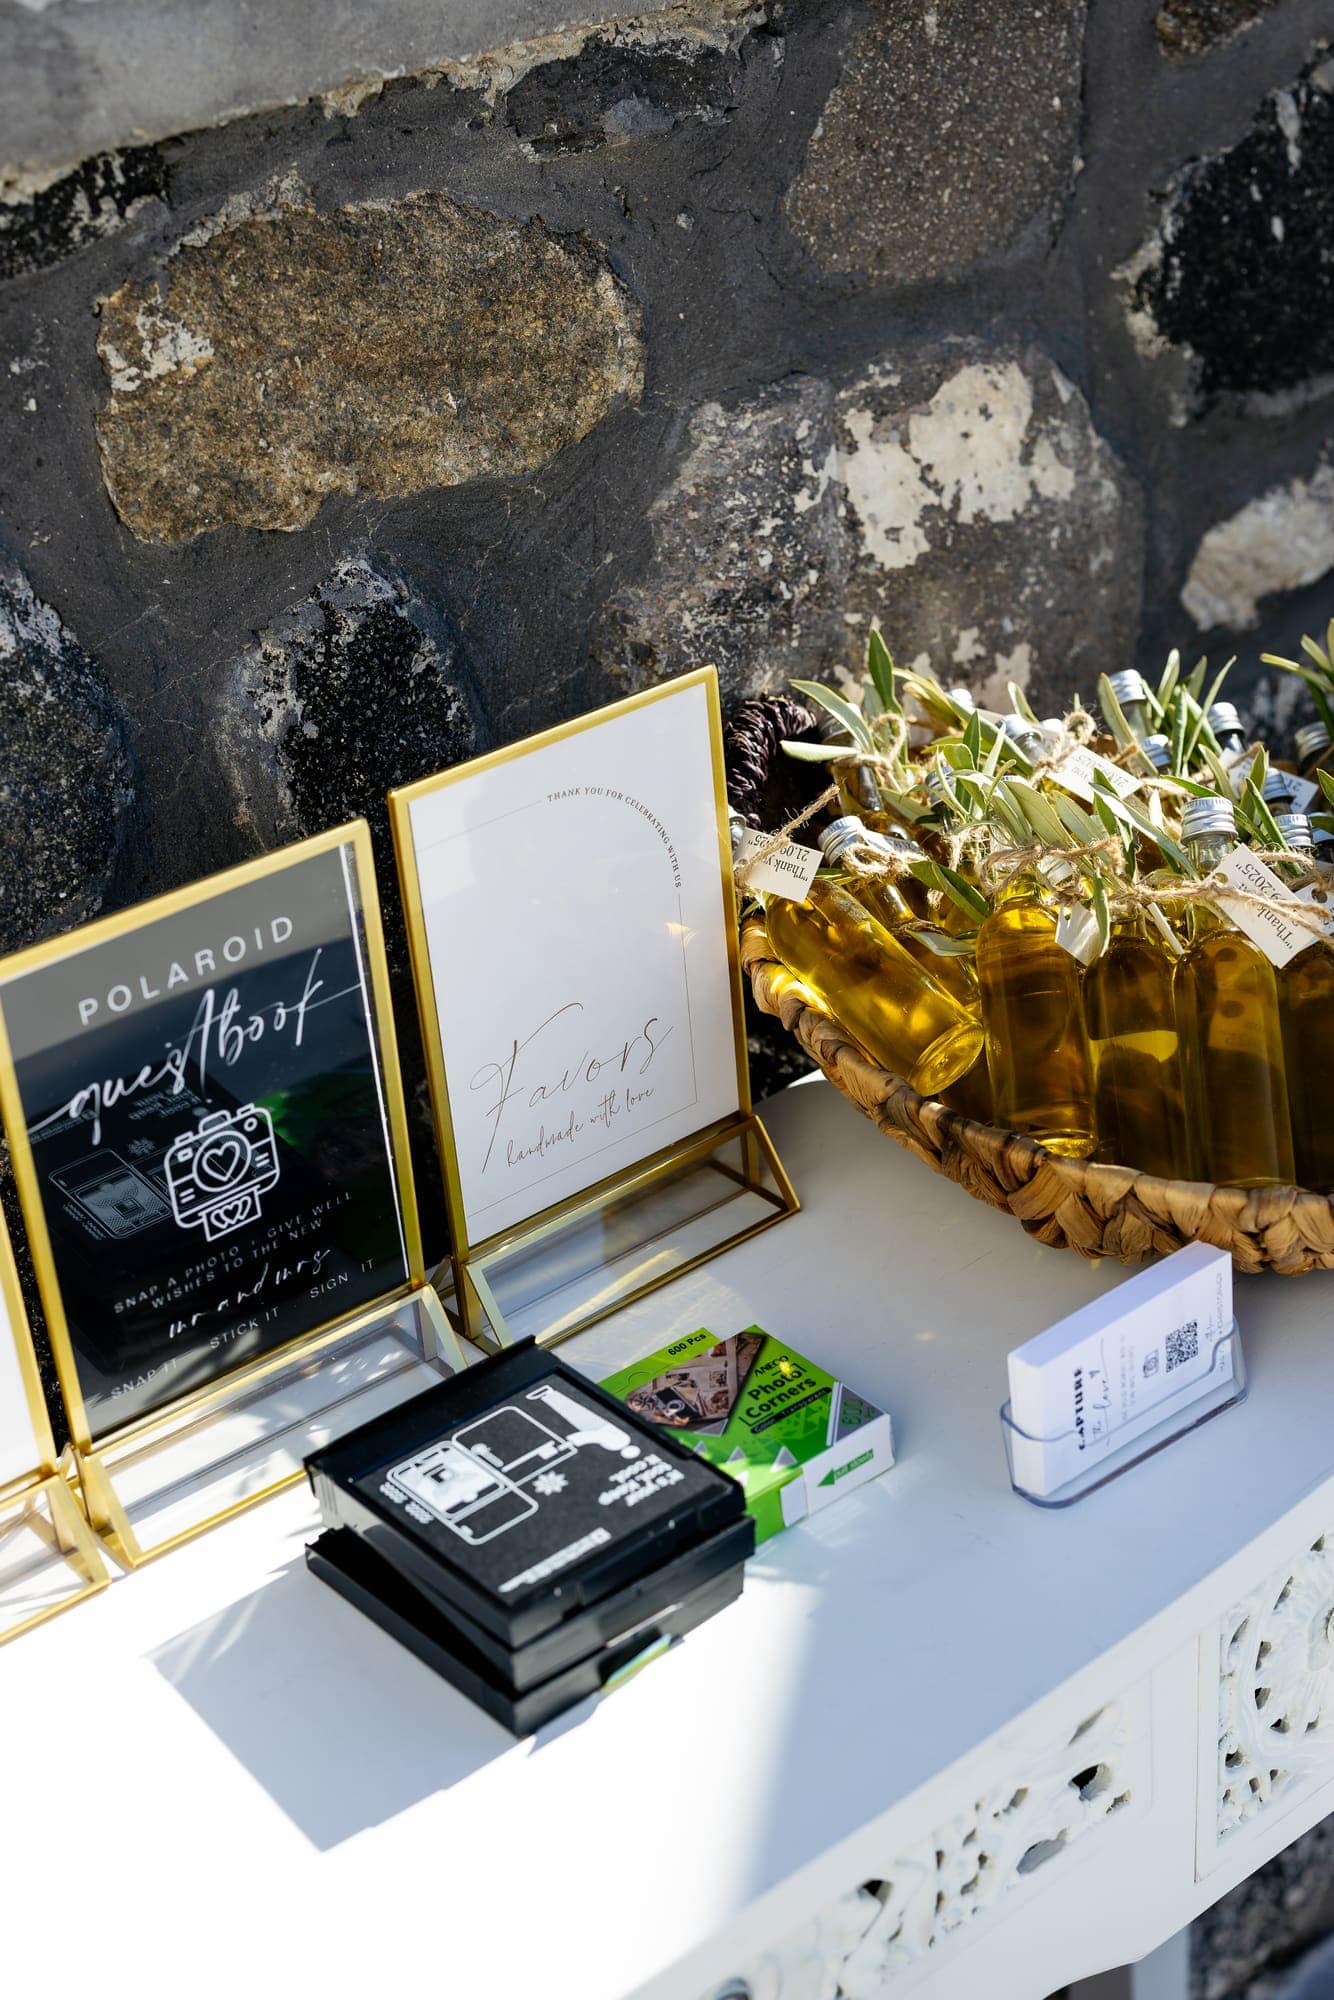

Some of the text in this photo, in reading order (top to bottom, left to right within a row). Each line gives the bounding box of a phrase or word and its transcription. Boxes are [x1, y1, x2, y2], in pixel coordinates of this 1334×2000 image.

[546, 786, 682, 888] THANK YOU FOR CELEBRATING WITH US
[78, 916, 293, 1025] POLAROID
[25, 947, 355, 1145] guestbook
[470, 1002, 674, 1174] Favors
[506, 1087, 656, 1167] handmade with love
[114, 1192, 352, 1313] SNAP A PHOTO GIVE WELL
[151, 1218, 322, 1309] WISHES TO THE NEW
[111, 1258, 374, 1399] SNAP IT STICK IT SIGN IT
[668, 1334, 707, 1355] 600 Pcs
[745, 1378, 816, 1418] Corners
[747, 1370, 802, 1400] Photo
